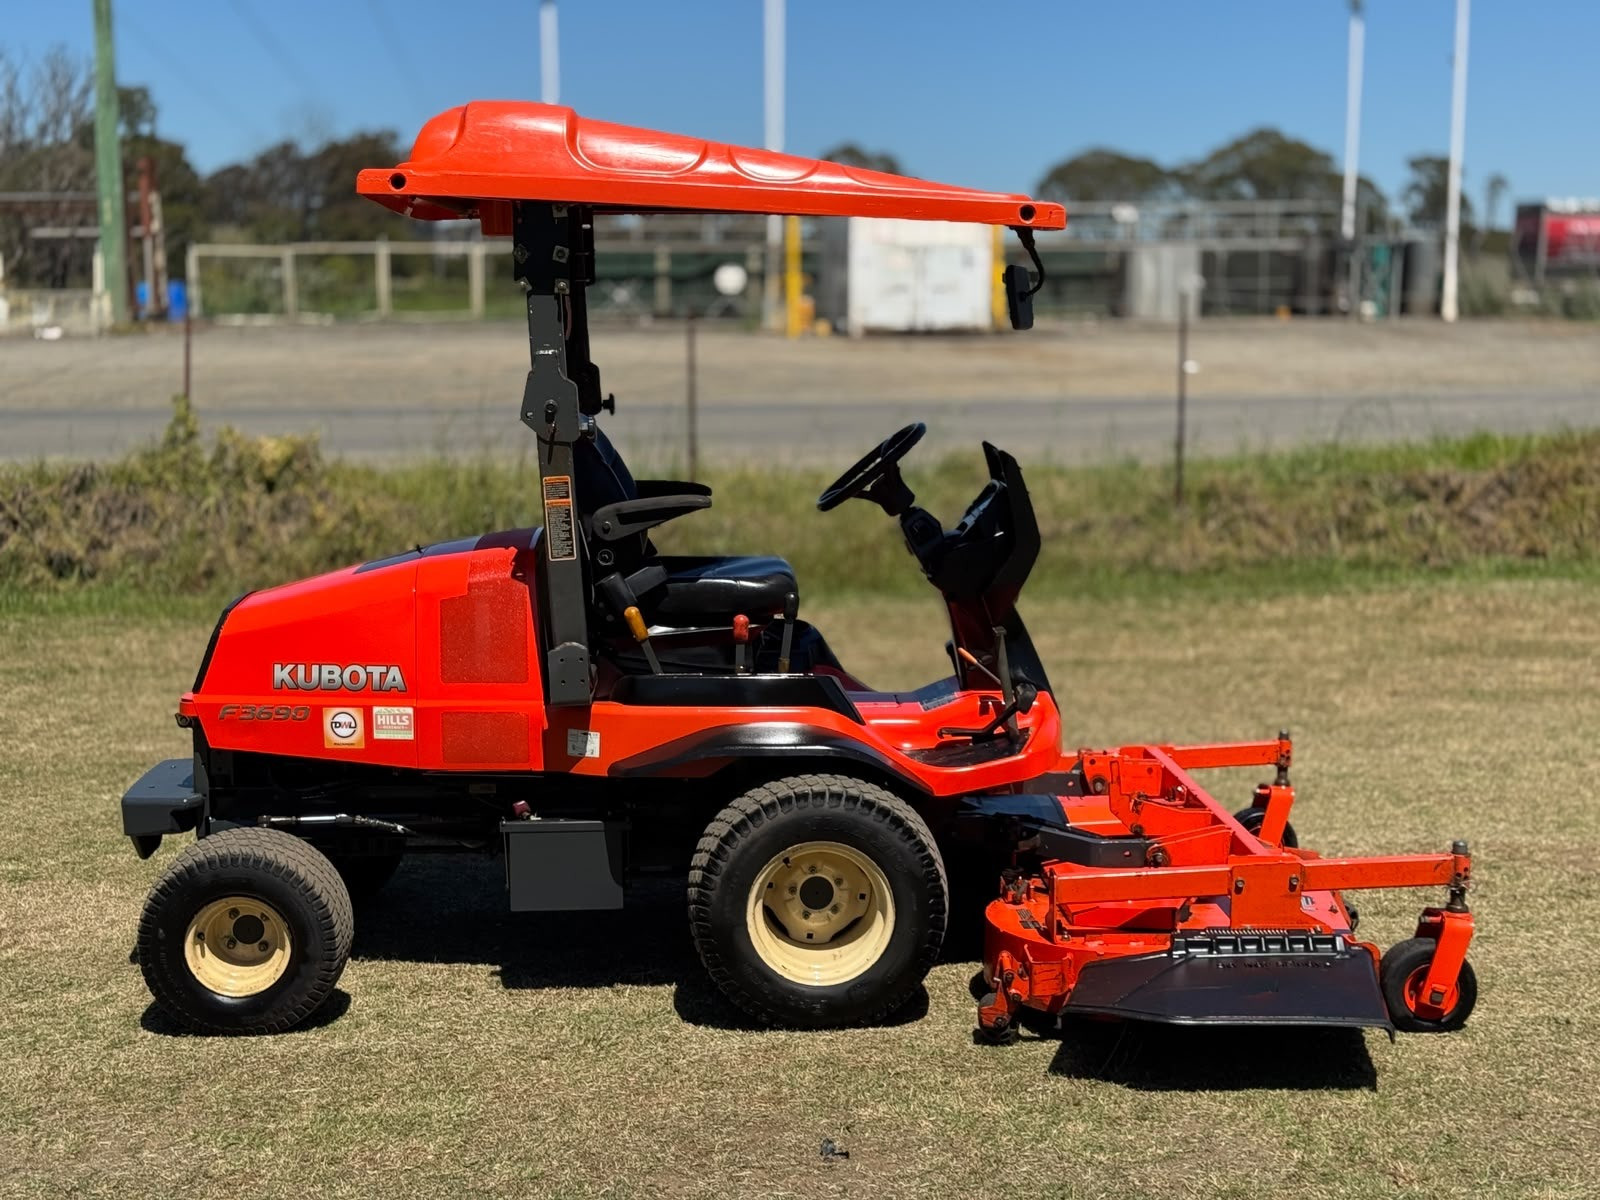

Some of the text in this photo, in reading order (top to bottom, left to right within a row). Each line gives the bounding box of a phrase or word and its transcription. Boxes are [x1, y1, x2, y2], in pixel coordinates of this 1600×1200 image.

[273, 663, 407, 692] KUBOTA
[218, 705, 311, 721] F3690
[377, 714, 410, 725] HILLS
[333, 721, 357, 729] DWL
